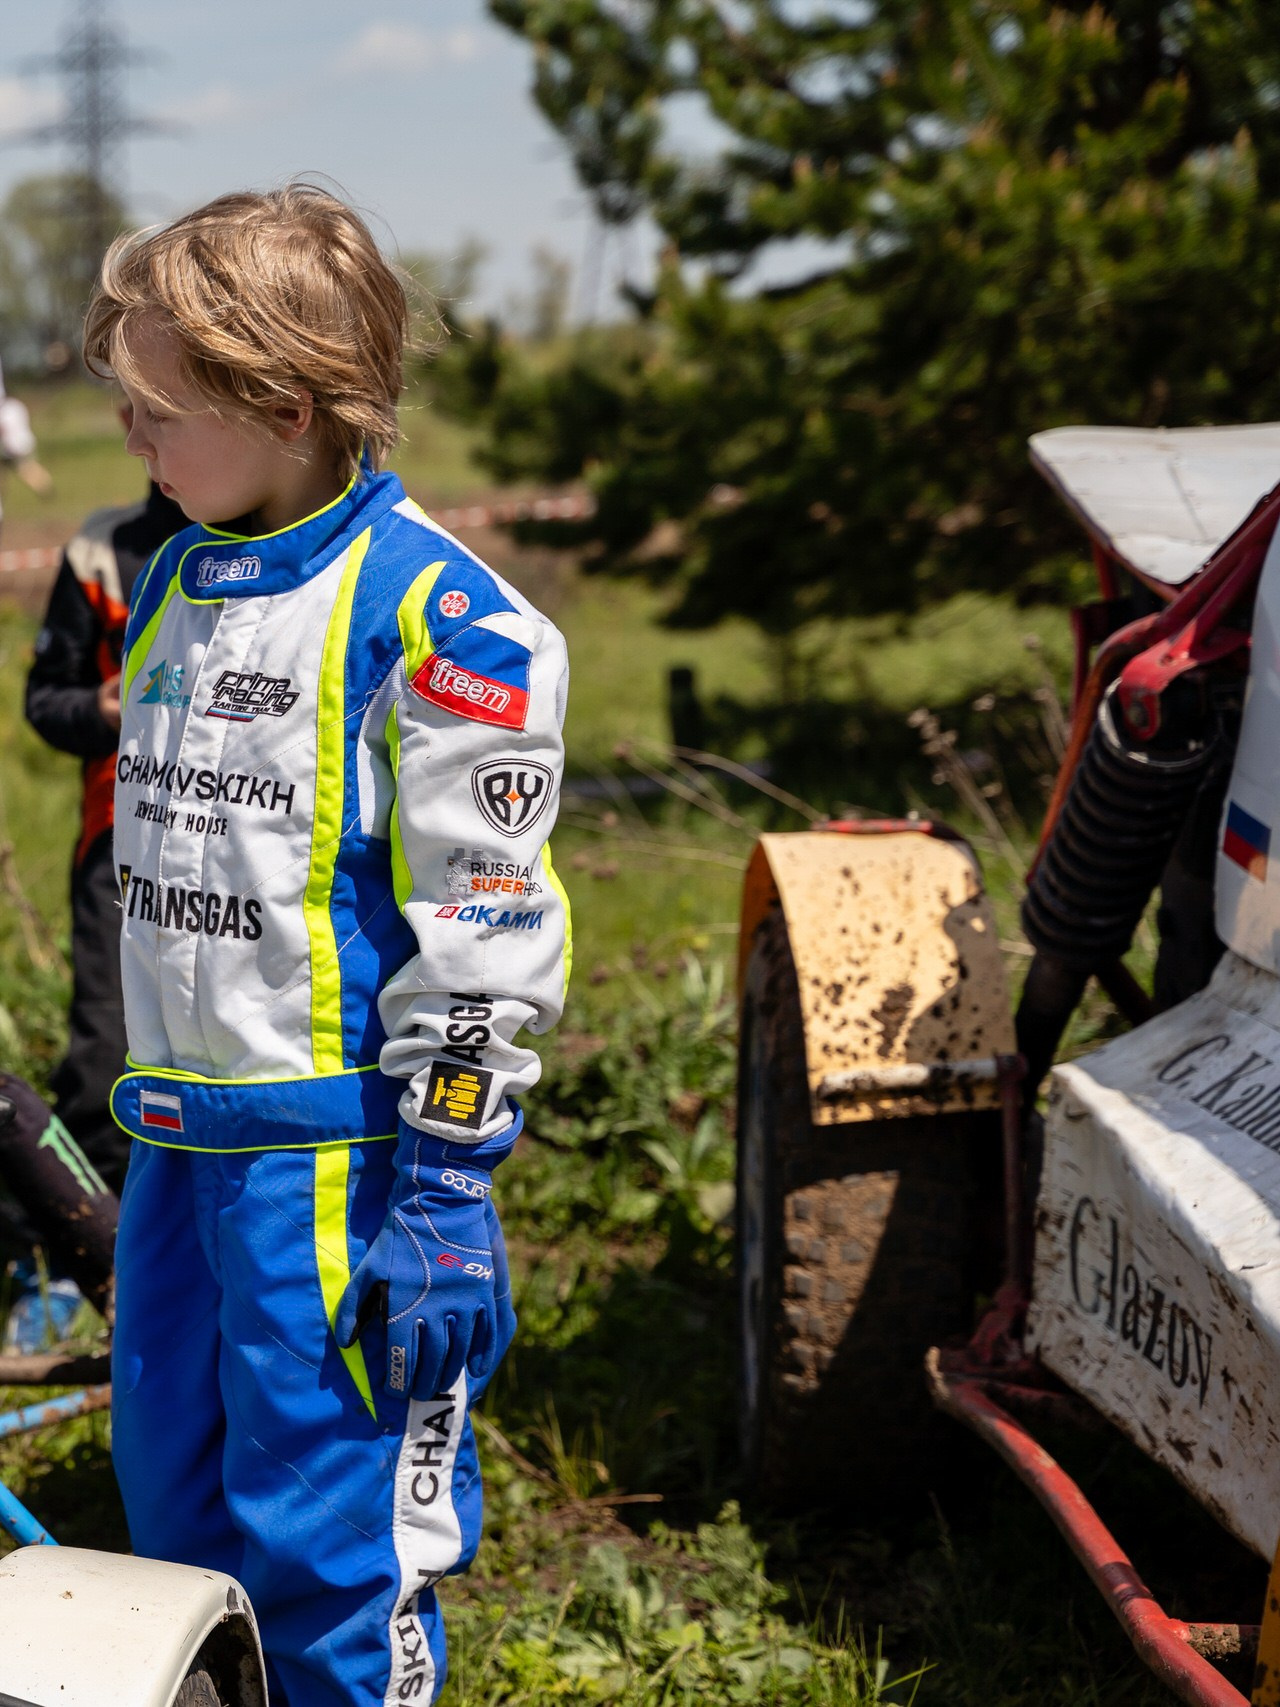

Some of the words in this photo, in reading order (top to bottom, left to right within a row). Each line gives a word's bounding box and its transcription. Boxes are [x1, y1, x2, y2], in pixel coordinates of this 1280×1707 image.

[199, 557, 260, 581] freem
[213, 701, 248, 712] KARTING
[251, 705, 271, 713] TEAM
[431, 659, 509, 711] freem
[118, 754, 296, 815] CHAMOVSKIKH
[185, 813, 228, 836] HOUSE
[128, 876, 263, 941] TRANSGAS
[1071, 1196, 1213, 1410] Glazov
[390, 1345, 406, 1392] sparco
